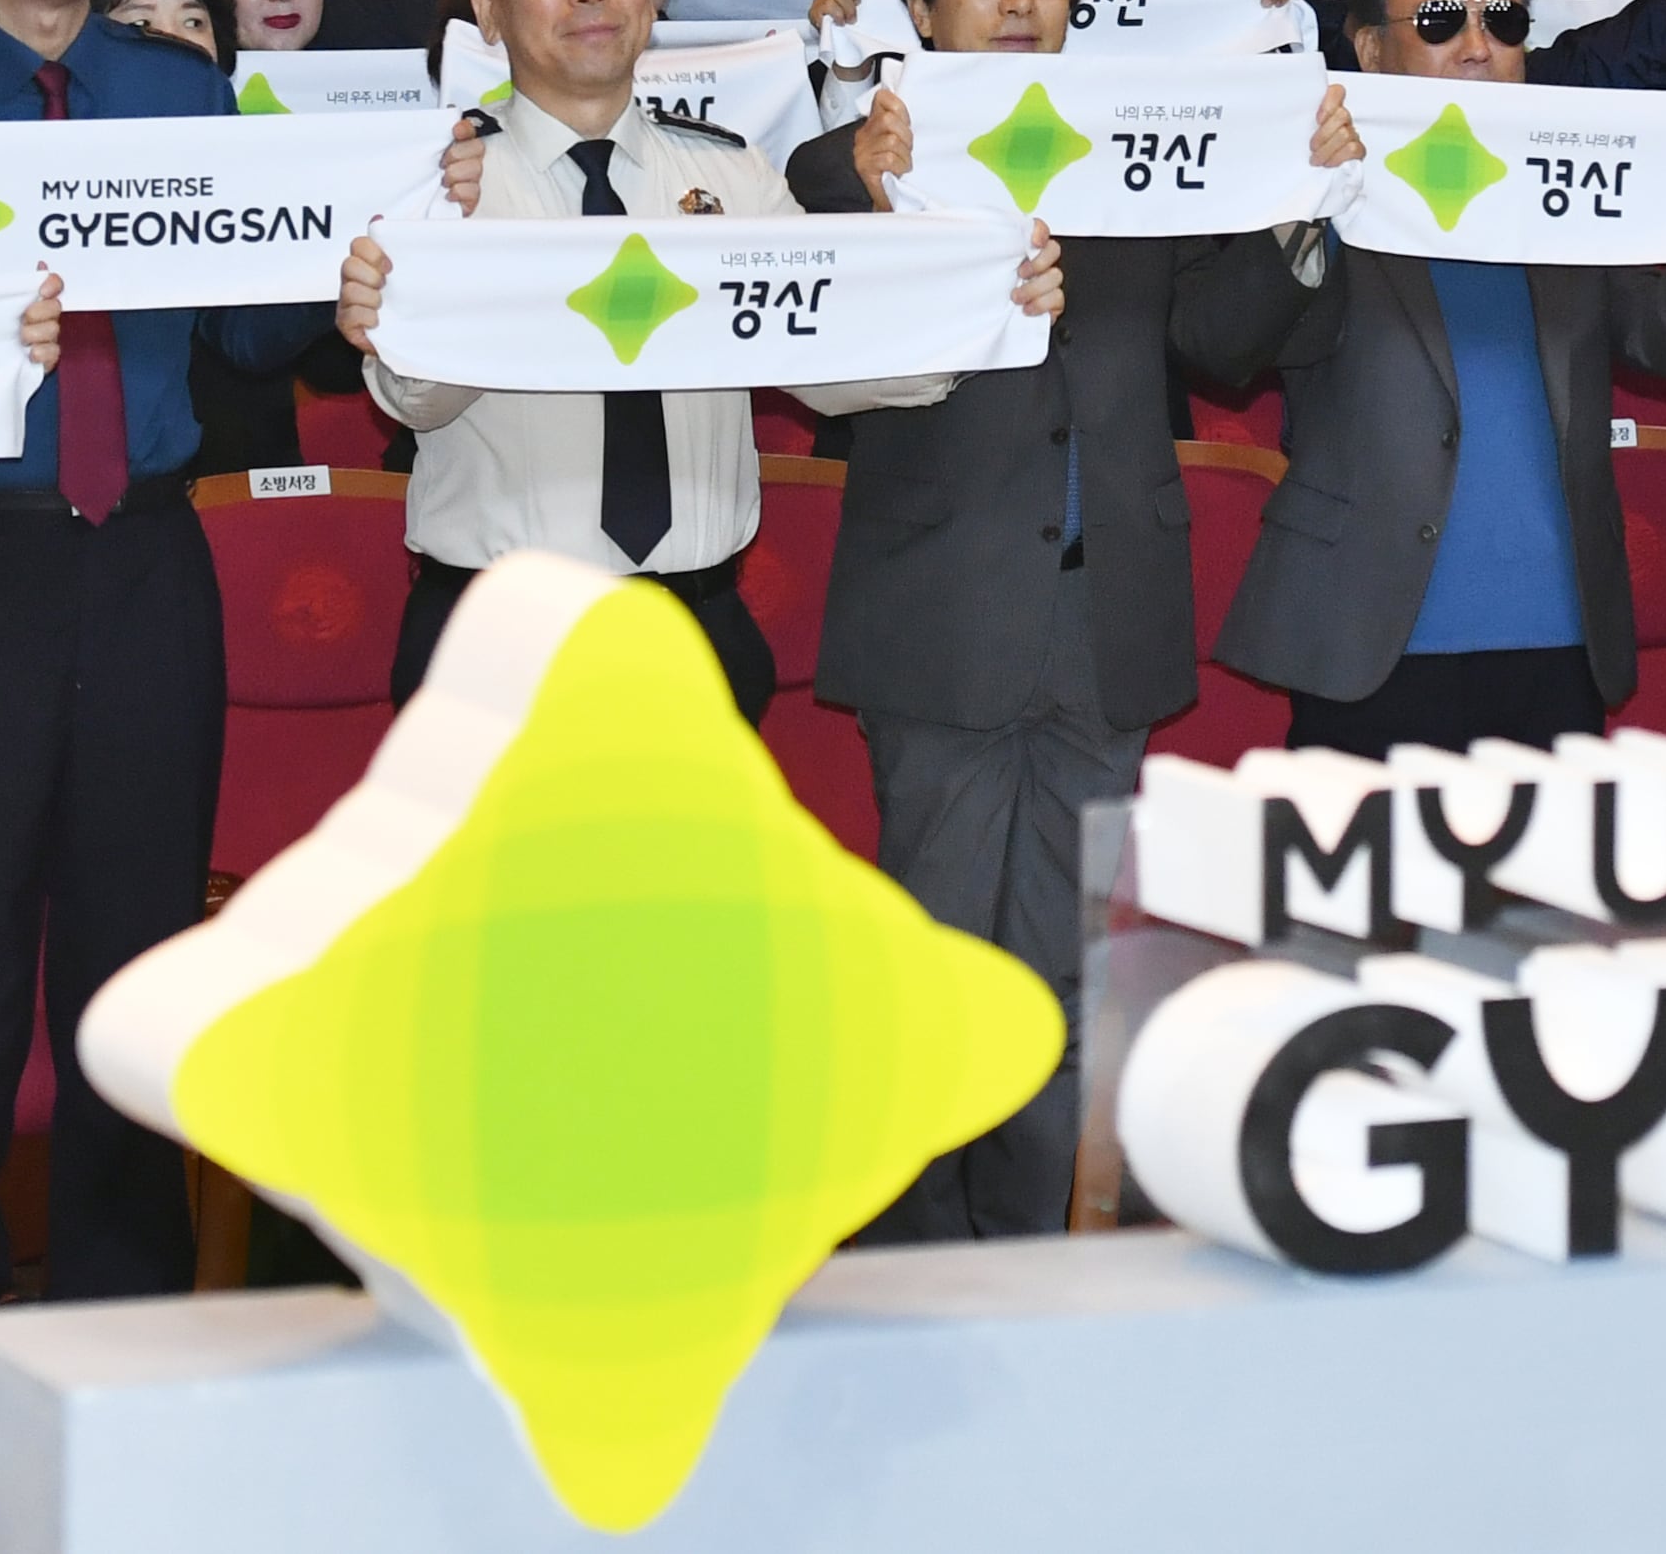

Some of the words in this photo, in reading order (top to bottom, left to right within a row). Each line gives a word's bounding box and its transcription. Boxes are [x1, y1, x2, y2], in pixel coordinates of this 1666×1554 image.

[43, 181, 79, 199] MY
[87, 177, 213, 199] UNIVERSE
[1112, 133, 1217, 191] 경산
[1526, 158, 1631, 217] 경산
[39, 205, 331, 248] GYEONGSAN
[720, 279, 831, 339] 경산
[261, 475, 319, 496] 소방서장
[1261, 780, 1539, 944] MY
